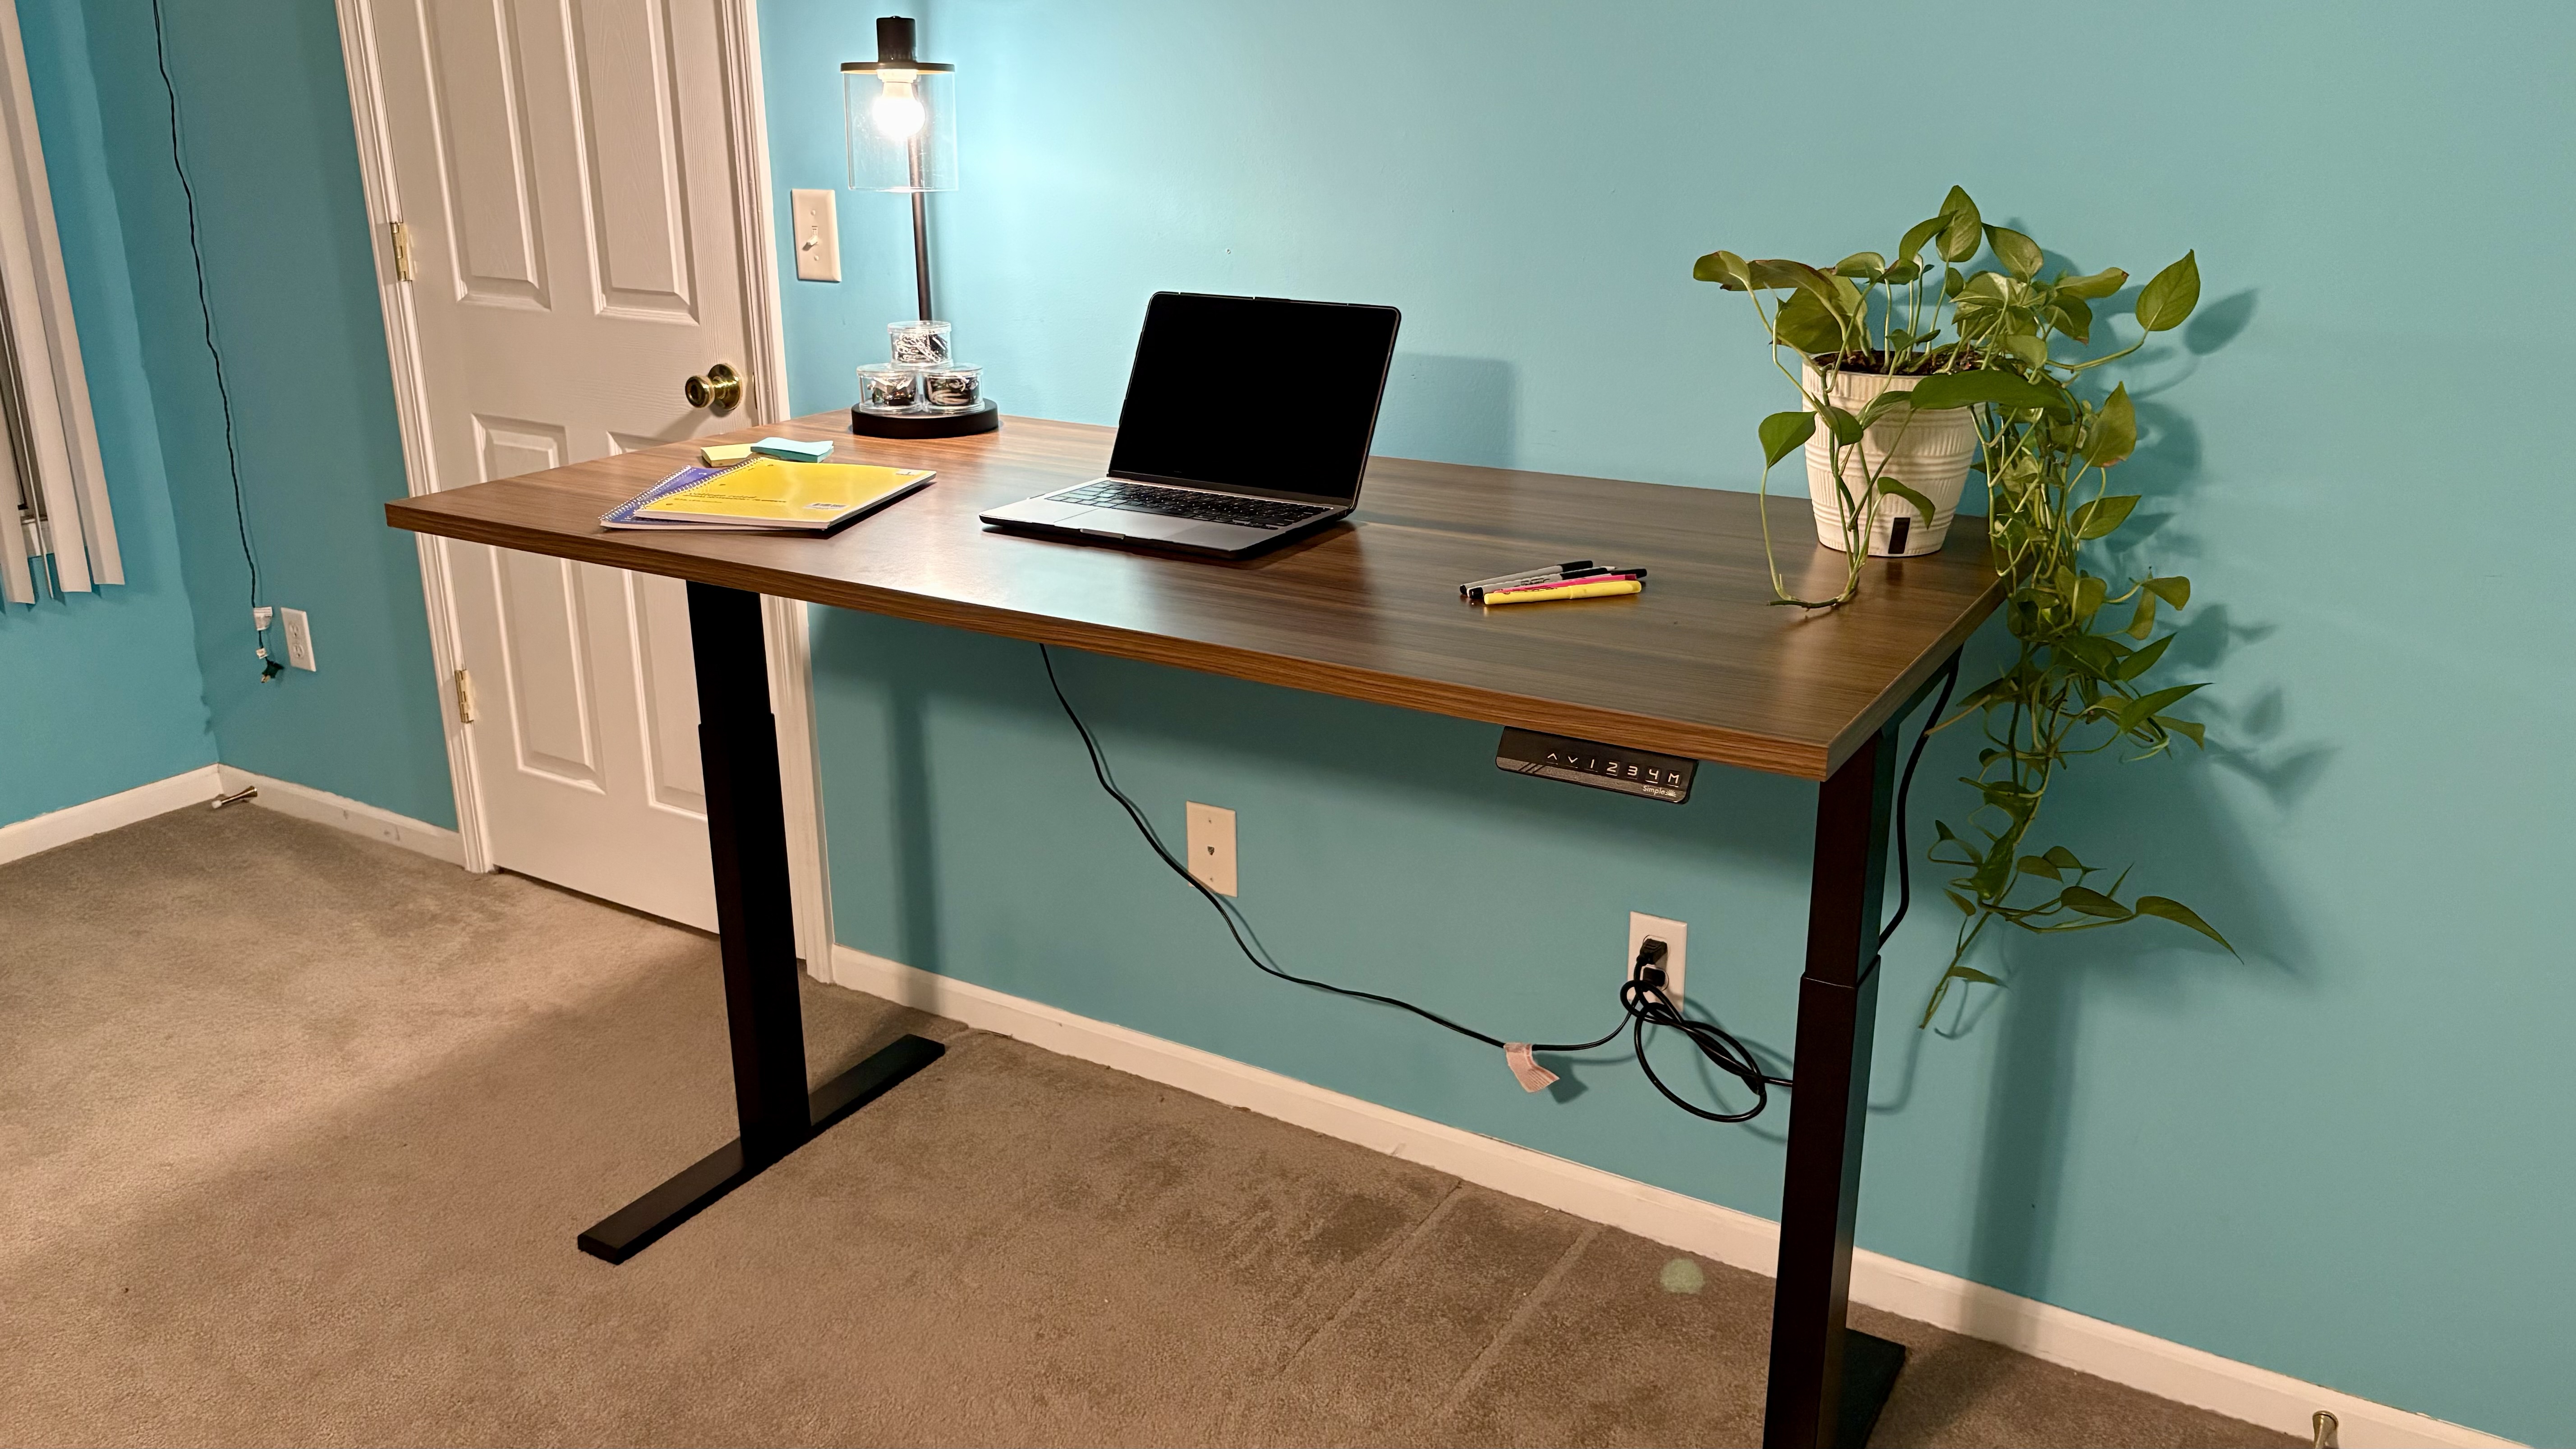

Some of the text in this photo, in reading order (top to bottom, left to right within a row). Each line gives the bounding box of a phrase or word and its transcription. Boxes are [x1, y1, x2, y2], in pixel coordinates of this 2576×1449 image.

[1590, 759, 1679, 784] 1 2 3 4 M
[1642, 785, 1665, 796] Simple
